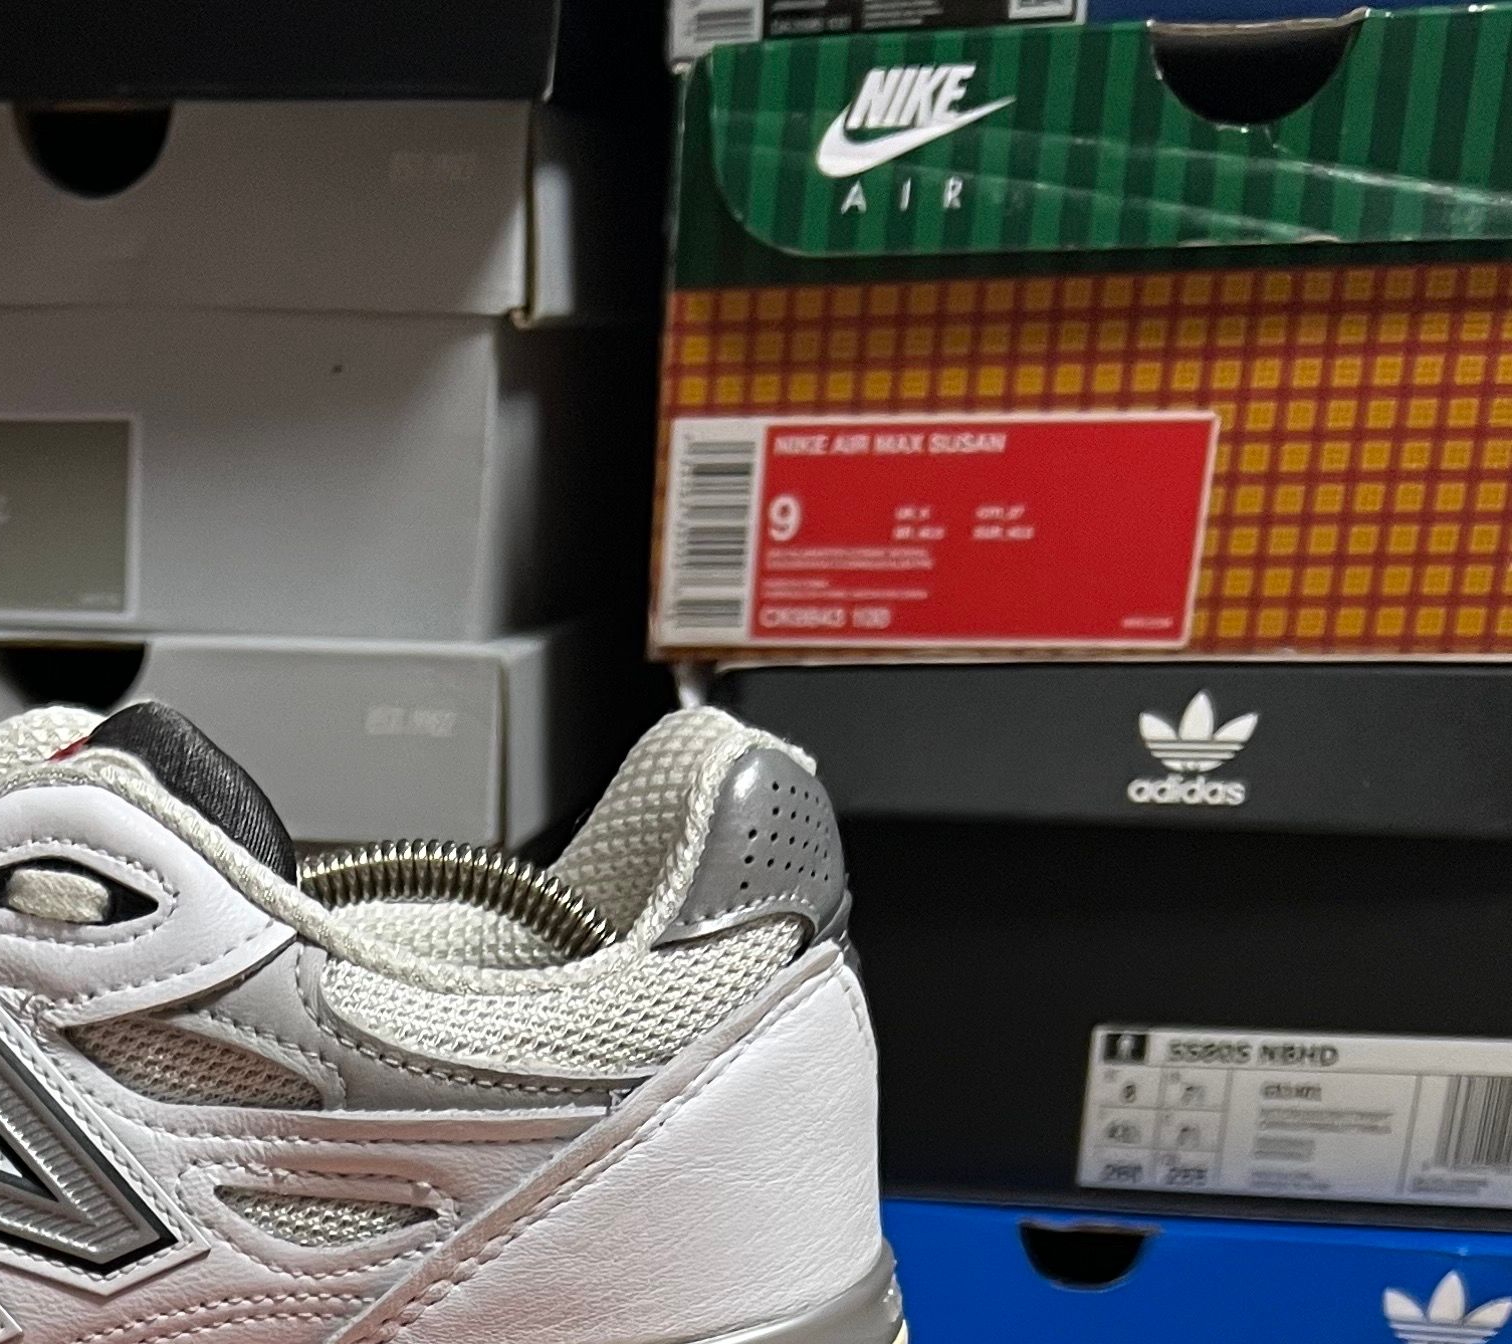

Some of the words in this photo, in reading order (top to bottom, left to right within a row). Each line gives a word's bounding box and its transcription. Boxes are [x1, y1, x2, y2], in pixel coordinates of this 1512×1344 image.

[845, 62, 977, 131] NIKE
[838, 178, 964, 215] AIR
[774, 435, 829, 456] NIKE
[874, 434, 925, 455] MAX
[929, 433, 1008, 455] SUSAN
[768, 495, 802, 542] 9
[1126, 774, 1246, 806] adidas
